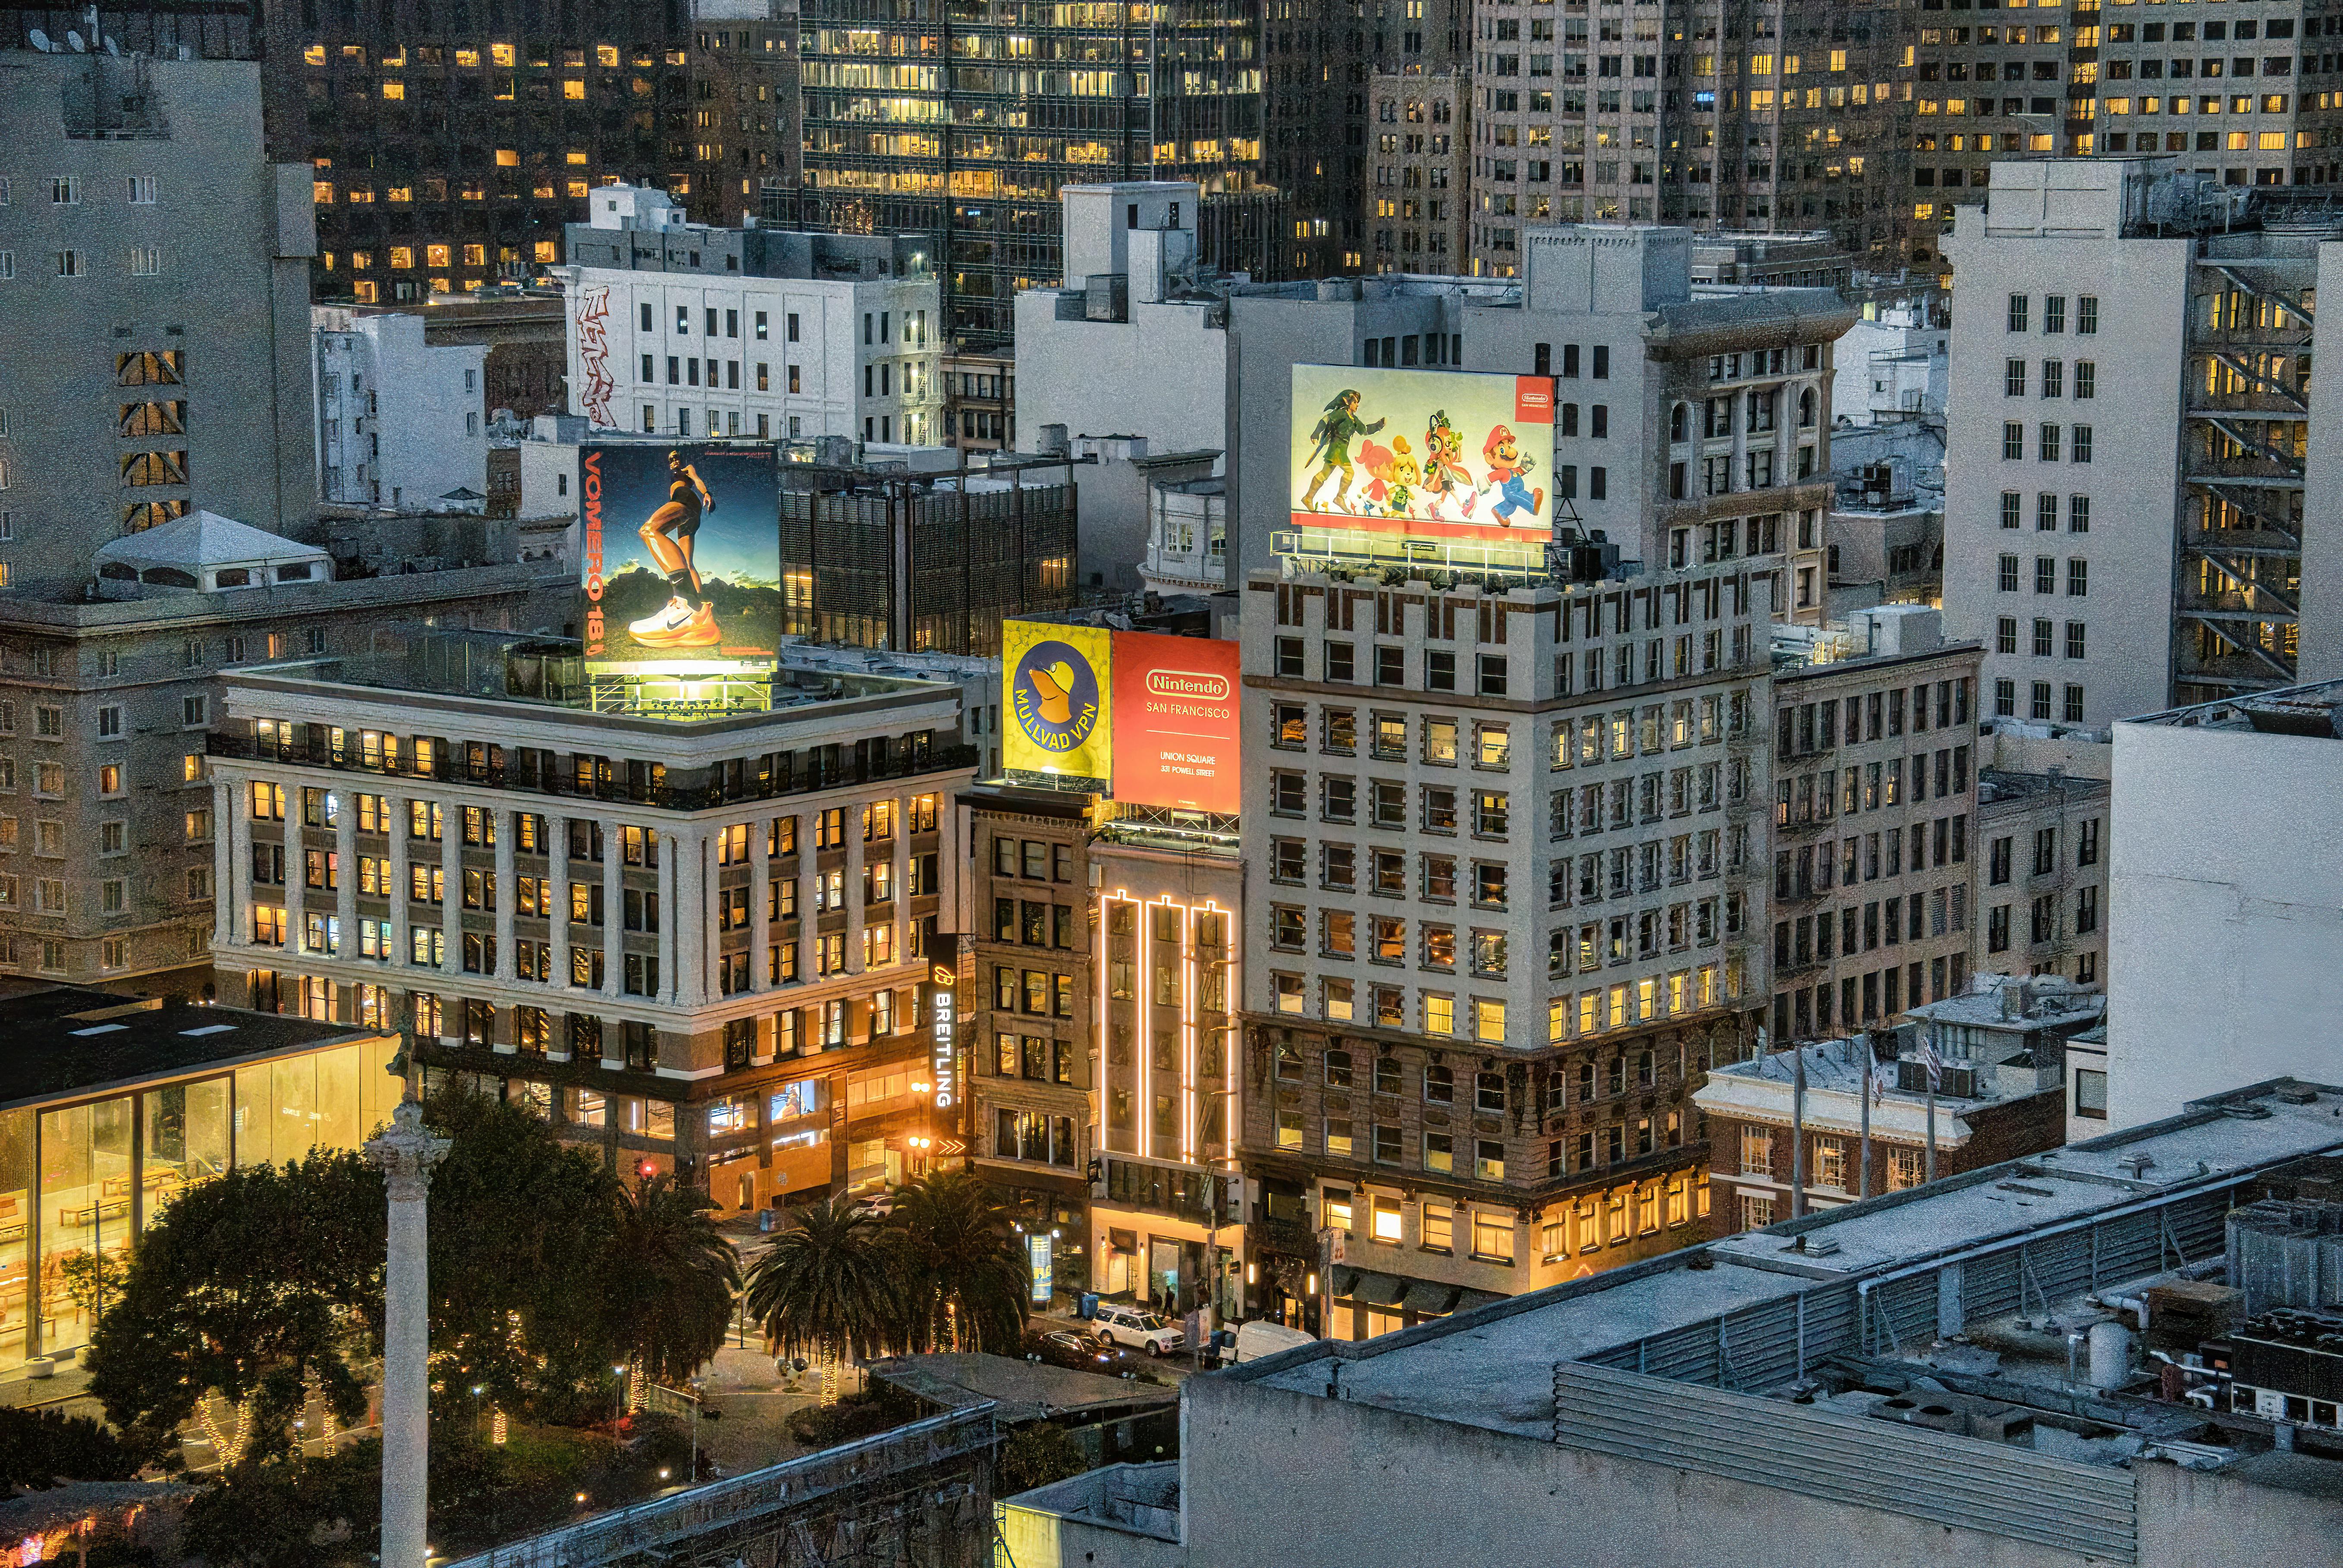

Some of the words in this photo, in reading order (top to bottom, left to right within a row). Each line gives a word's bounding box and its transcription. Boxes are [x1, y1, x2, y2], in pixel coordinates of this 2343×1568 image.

[585, 451, 603, 601] VOMERO
[587, 605, 604, 641] 18
[1154, 676, 1222, 694] Nintendo
[1015, 689, 1070, 749] MULLVAD
[1070, 702, 1096, 740] VPN
[1146, 702, 1167, 713] SAN
[1171, 704, 1229, 719] FRANCISCO
[1160, 751, 1184, 761] UNION
[1187, 754, 1215, 765] SQUARE
[1172, 766, 1195, 775] POWELL
[1196, 769, 1215, 777] STREET
[936, 993, 951, 1107] BREITLING
